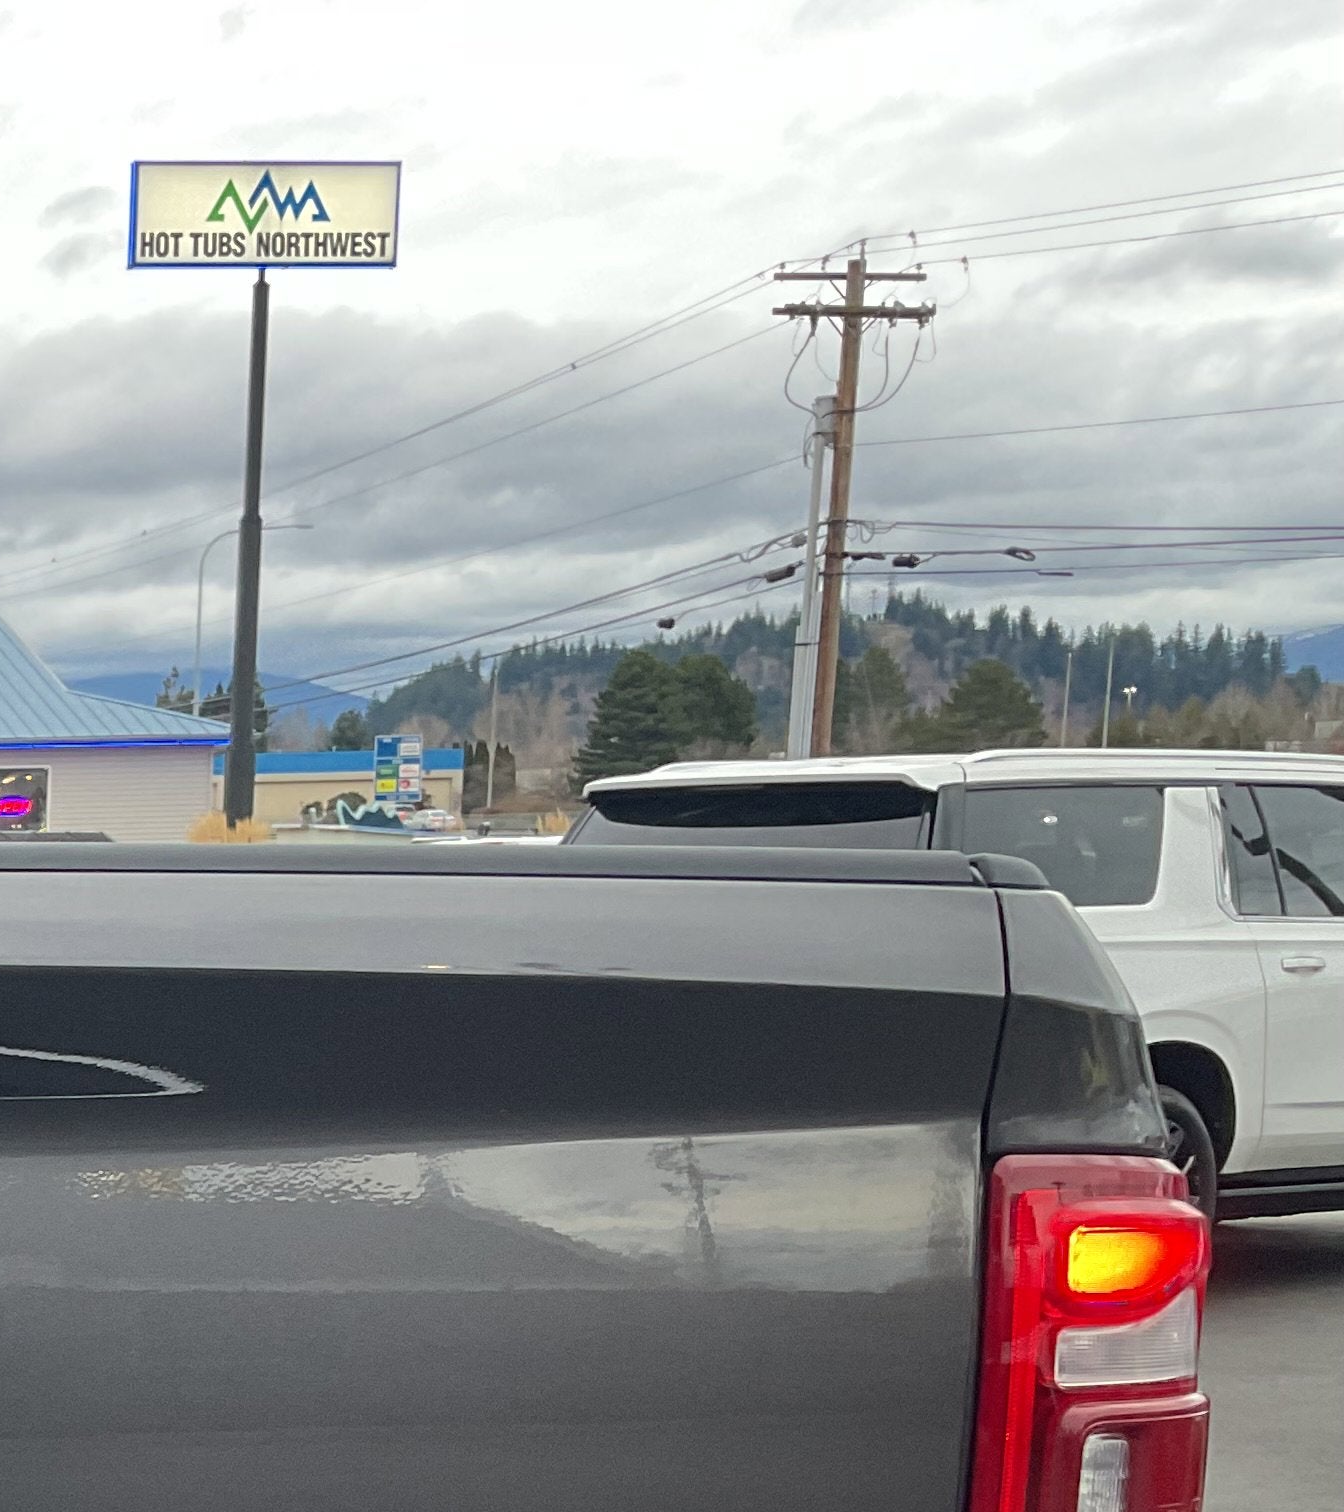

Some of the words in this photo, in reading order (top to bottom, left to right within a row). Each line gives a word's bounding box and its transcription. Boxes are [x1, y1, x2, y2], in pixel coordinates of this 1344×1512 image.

[139, 232, 183, 258] HOT
[189, 232, 246, 258] TUBS
[256, 231, 391, 258] NORTHWEST
